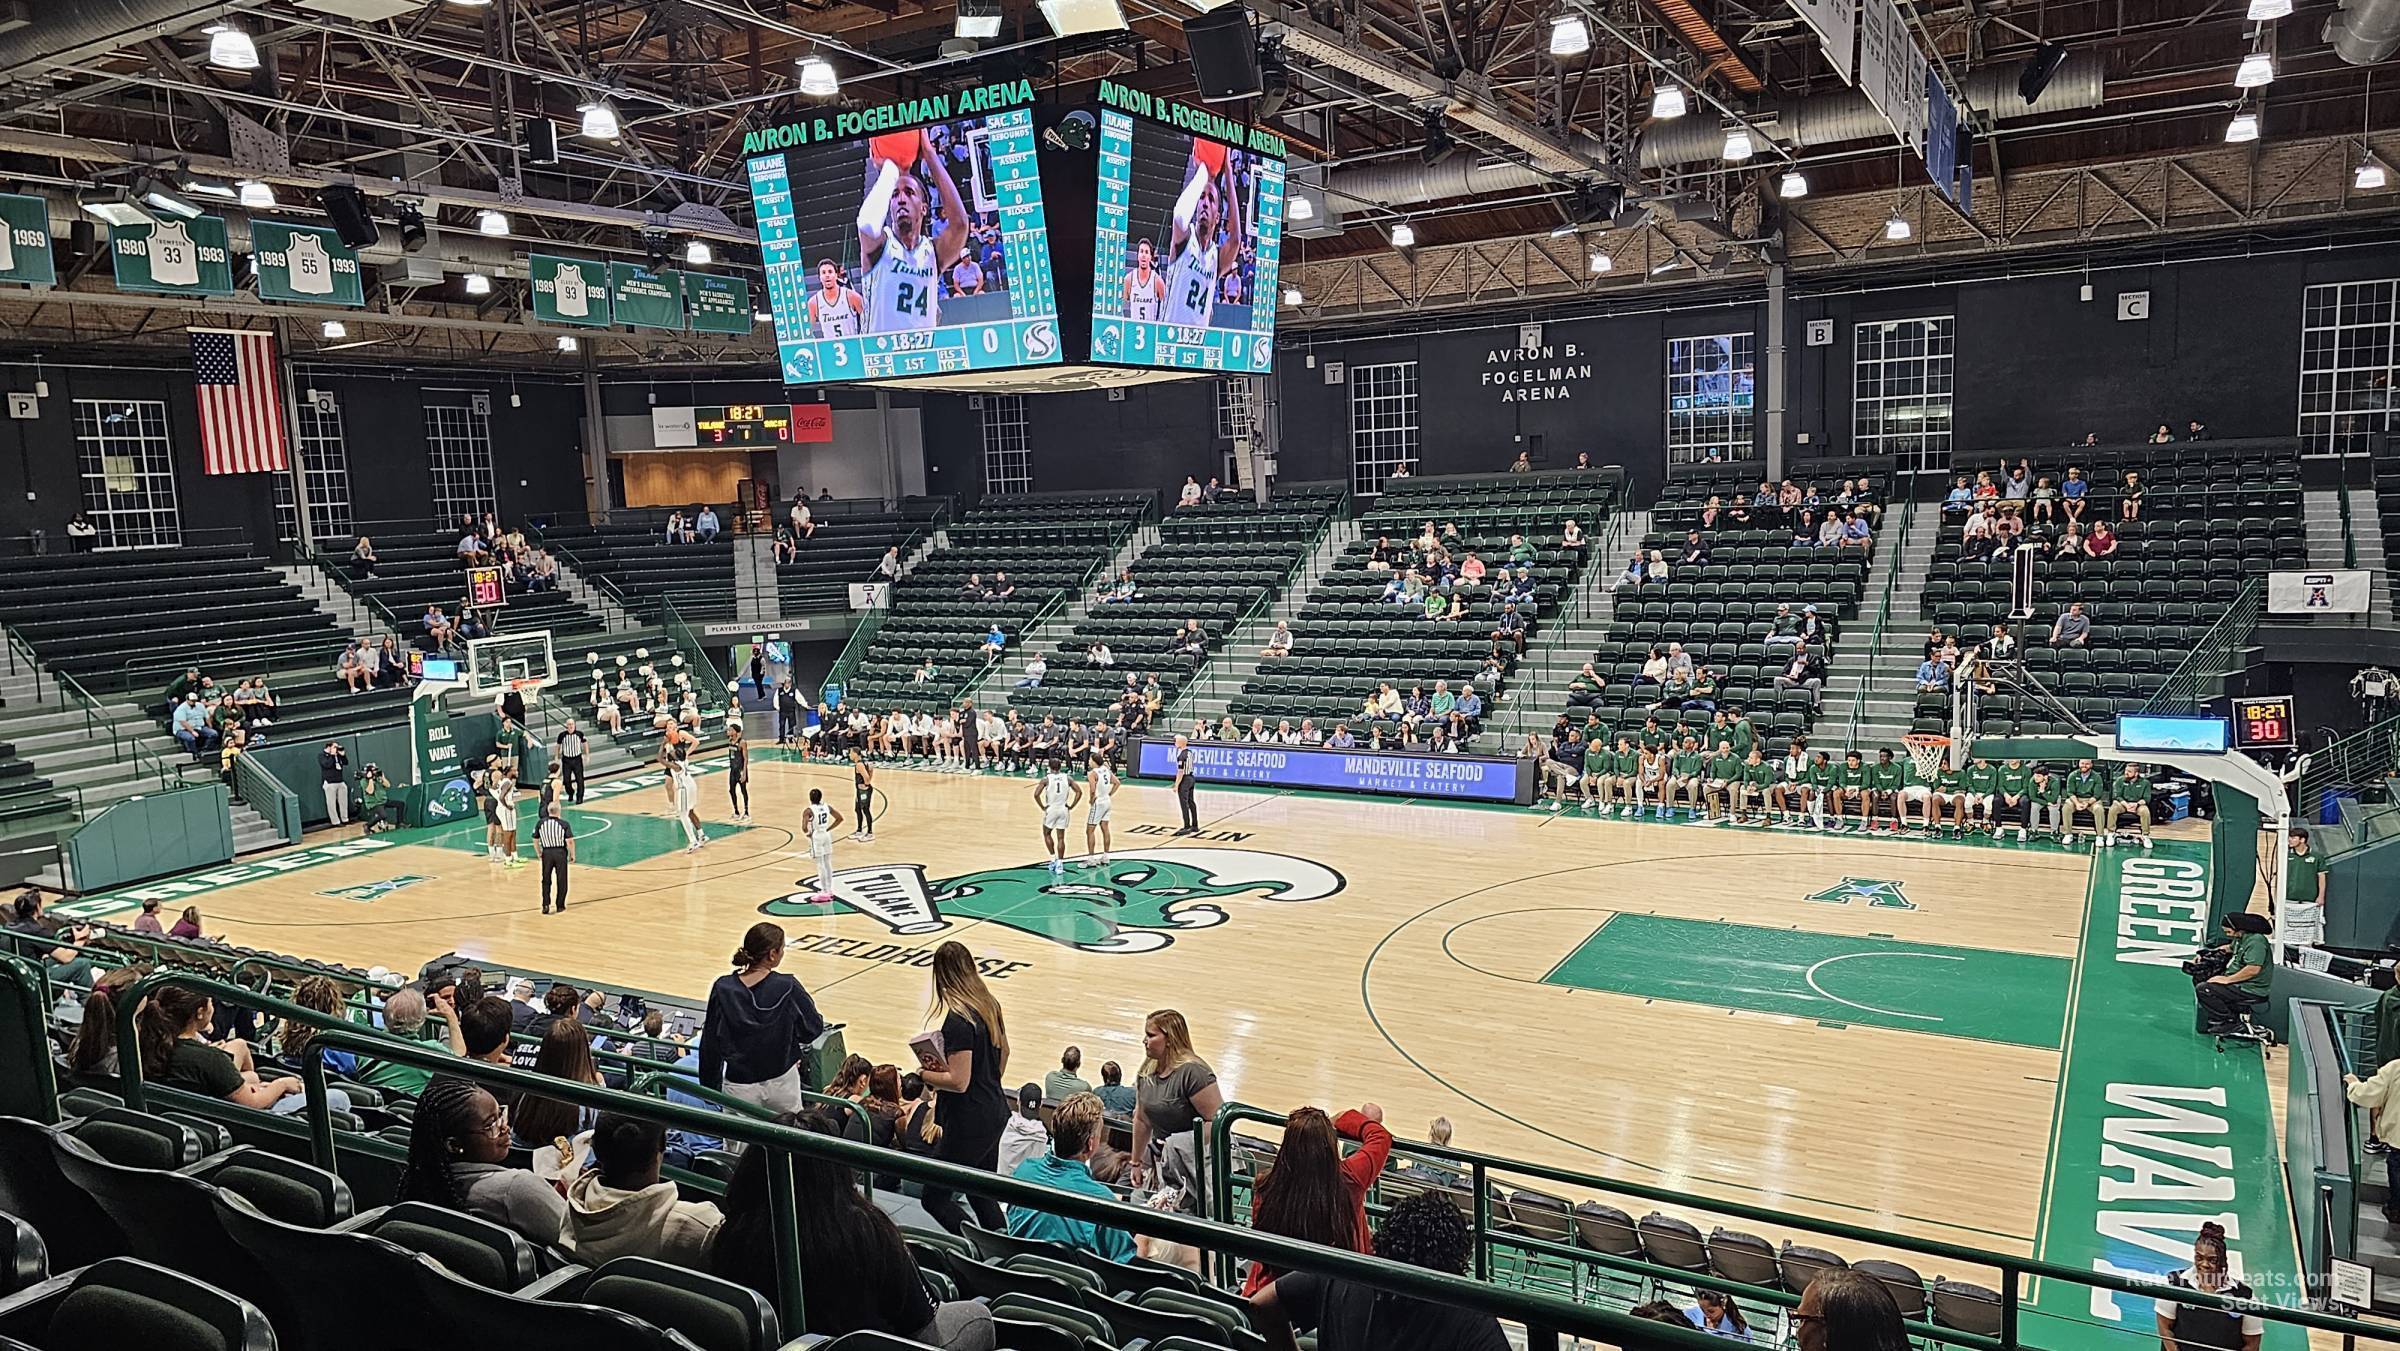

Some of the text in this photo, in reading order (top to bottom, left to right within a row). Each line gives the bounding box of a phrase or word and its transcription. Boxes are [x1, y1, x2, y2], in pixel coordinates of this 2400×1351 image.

[742, 79, 1035, 154] AVRON B. FOGELMAN ARENA
[1098, 79, 1287, 158] AVRON B. FOGELMAN ARENA
[1104, 113, 1132, 132] TULANE
[1008, 142, 1016, 154] 2
[1114, 142, 1120, 154] 2
[751, 157, 785, 172] TULANE
[1011, 168, 1019, 179] 0
[1113, 168, 1118, 179] 1
[768, 182, 775, 193] 2
[1004, 181, 1030, 192] STEALS
[1015, 193, 1023, 205] 0
[1111, 193, 1118, 203] 0
[772, 206, 778, 216] 1
[1017, 219, 1026, 230] 0
[1110, 218, 1117, 229] 0
[12, 228, 47, 248] 1969
[776, 228, 782, 238] 0
[115, 238, 146, 256] 1980
[163, 246, 182, 264] 33
[197, 246, 225, 263] 1983
[258, 250, 286, 267] 1989
[780, 252, 786, 261] 0
[301, 258, 318, 275] 55
[331, 257, 356, 274] 1993
[534, 279, 555, 293] 1989
[565, 286, 577, 300] 93
[587, 285, 606, 299] 1993
[896, 281, 928, 317] 24
[1185, 279, 1209, 315] 24
[1139, 306, 1145, 320] 5
[2127, 301, 2140, 316] C
[833, 324, 843, 338] 5
[1814, 328, 1825, 342] B
[833, 327, 999, 367] 3 18:27 0
[1134, 325, 1242, 358] 3 18:27 0
[1182, 351, 1197, 364] 1ST
[1487, 344, 1585, 364] AVRON B.
[903, 357, 926, 371] 1ST
[1330, 369, 1339, 382] T
[1482, 364, 1591, 386] FOGELMAN
[1113, 388, 1120, 399] S
[1501, 385, 1570, 403] ARENA
[18, 401, 29, 416] P
[318, 399, 330, 412] Q
[477, 401, 486, 413] R
[972, 399, 980, 408] R
[729, 406, 762, 420] 18:27
[714, 428, 788, 442] 3 1 0
[473, 570, 497, 584] 18:27
[475, 582, 497, 603] 30
[751, 623, 783, 631] COACHES
[2247, 705, 2286, 720] 18:27
[428, 726, 452, 742] ROLL
[2250, 720, 2281, 740] 30
[428, 744, 457, 762] WAVE
[1167, 747, 1286, 769] MDEVILLE SEAFOOD
[1193, 766, 1216, 776] RKET
[1234, 769, 1271, 780] EATERY
[1344, 757, 1483, 782] MANDEVILLE SEAFOOD
[1103, 775, 1108, 785] 5
[1359, 777, 1401, 789] MARKET
[1423, 782, 1466, 793] EATERY
[817, 812, 828, 825] 12
[1124, 824, 1256, 842] DELIN
[49, 837, 395, 918] GREEN
[844, 873, 920, 919] TULANE
[2115, 857, 2208, 968] GREEN
[787, 933, 1034, 979] FIELDHOSE
[512, 1055, 537, 1067] LOVE
